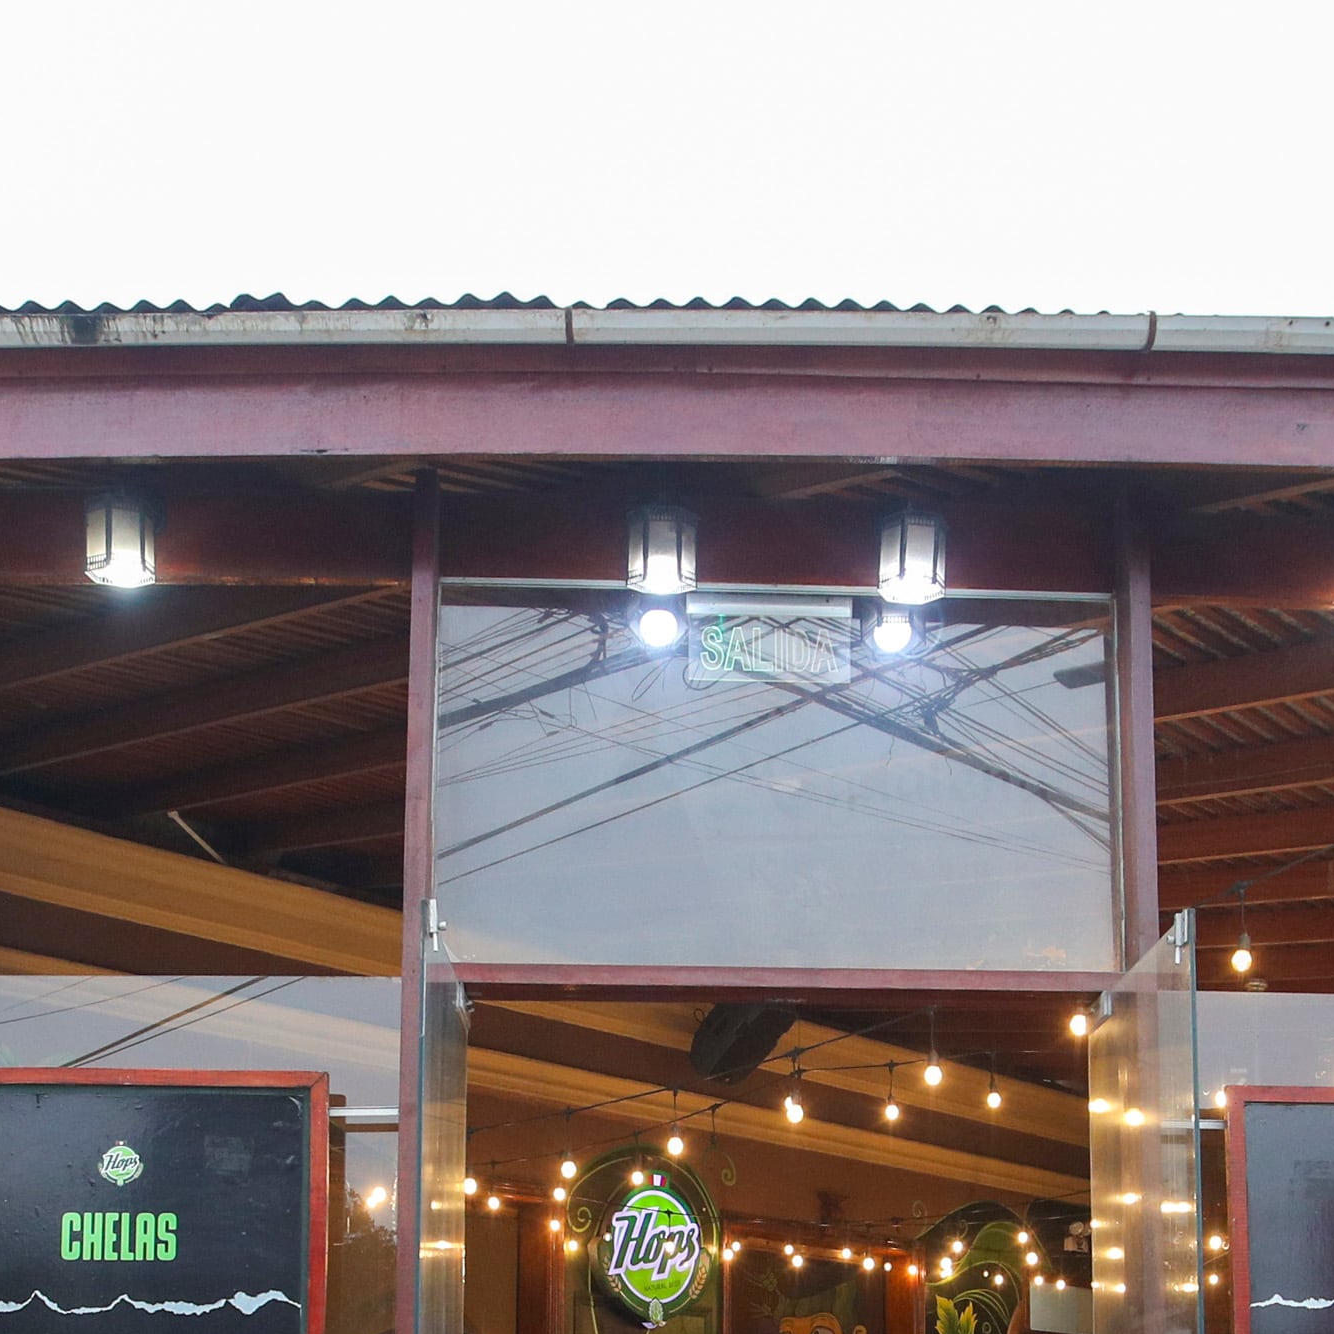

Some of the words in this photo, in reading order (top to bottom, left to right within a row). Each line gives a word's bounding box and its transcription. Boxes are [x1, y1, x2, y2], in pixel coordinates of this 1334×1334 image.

[700, 625, 839, 673] SALIDA
[102, 1151, 140, 1173] Hops
[60, 1211, 178, 1262] CHELAS
[609, 1206, 699, 1280] Hops
